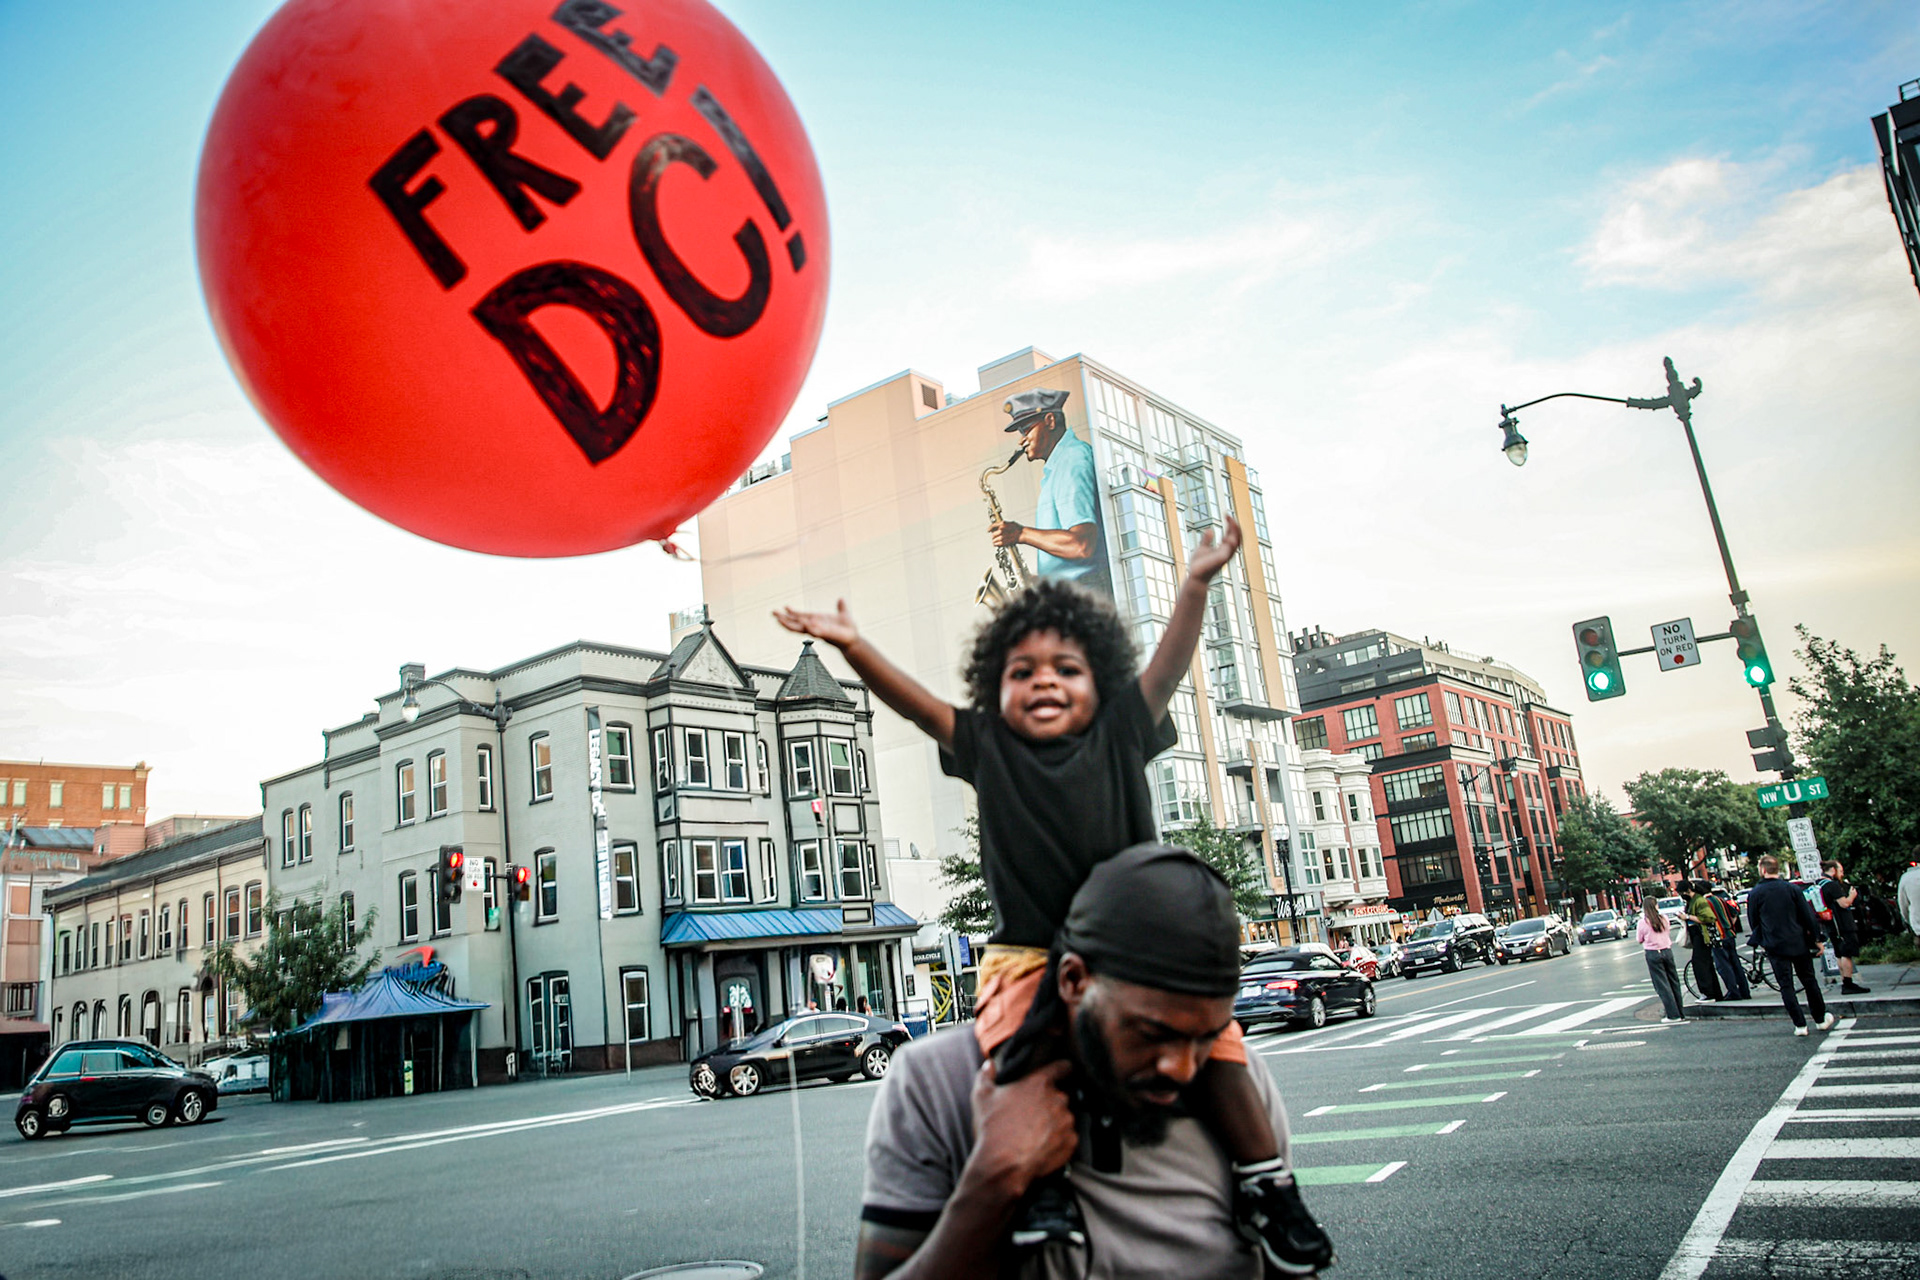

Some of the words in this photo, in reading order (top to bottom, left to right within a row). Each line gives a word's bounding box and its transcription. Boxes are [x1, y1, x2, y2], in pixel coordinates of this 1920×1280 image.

[367, 0, 680, 291] FREE
[469, 84, 808, 467] DC!
[1662, 624, 1680, 635] NO
[1663, 634, 1686, 645] TURN
[1660, 647, 1672, 656] ON
[1676, 643, 1693, 653] RED
[1761, 792, 1778, 804] NW
[1782, 783, 1802, 801] U
[1808, 783, 1822, 795] ST
[1432, 893, 1466, 904] Madewell
[914, 952, 941, 961] SOULCYCLE
